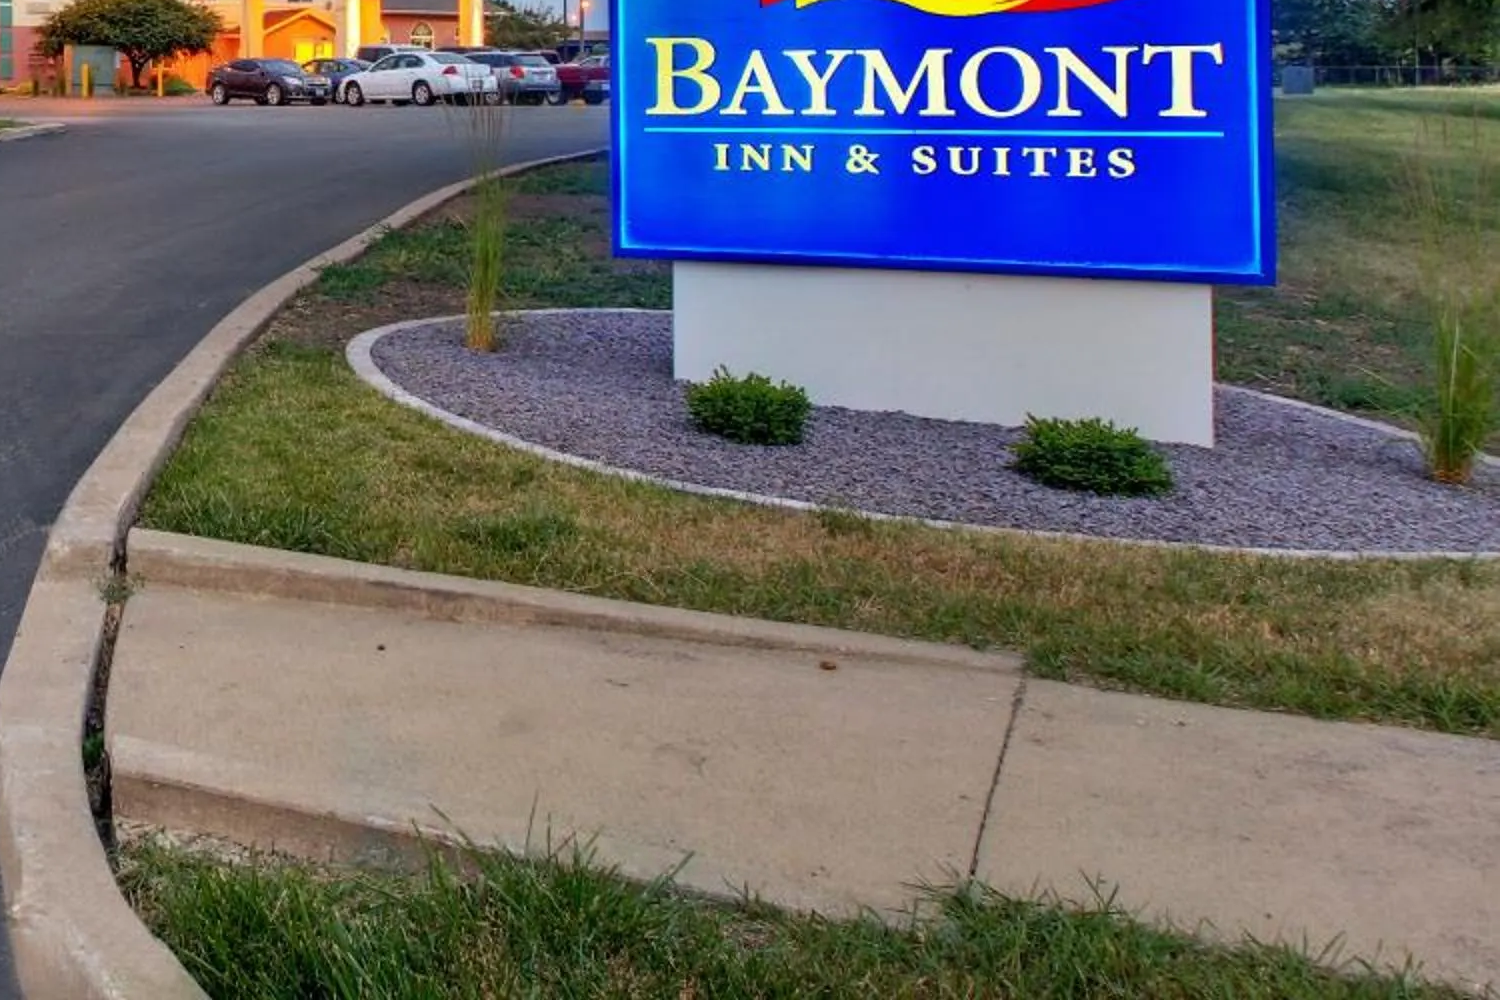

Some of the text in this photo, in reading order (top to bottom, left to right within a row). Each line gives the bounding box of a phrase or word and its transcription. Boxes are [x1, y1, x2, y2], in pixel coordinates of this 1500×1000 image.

[645, 37, 1223, 118] BAYMONT
[714, 143, 1136, 178] INN & SUITES
